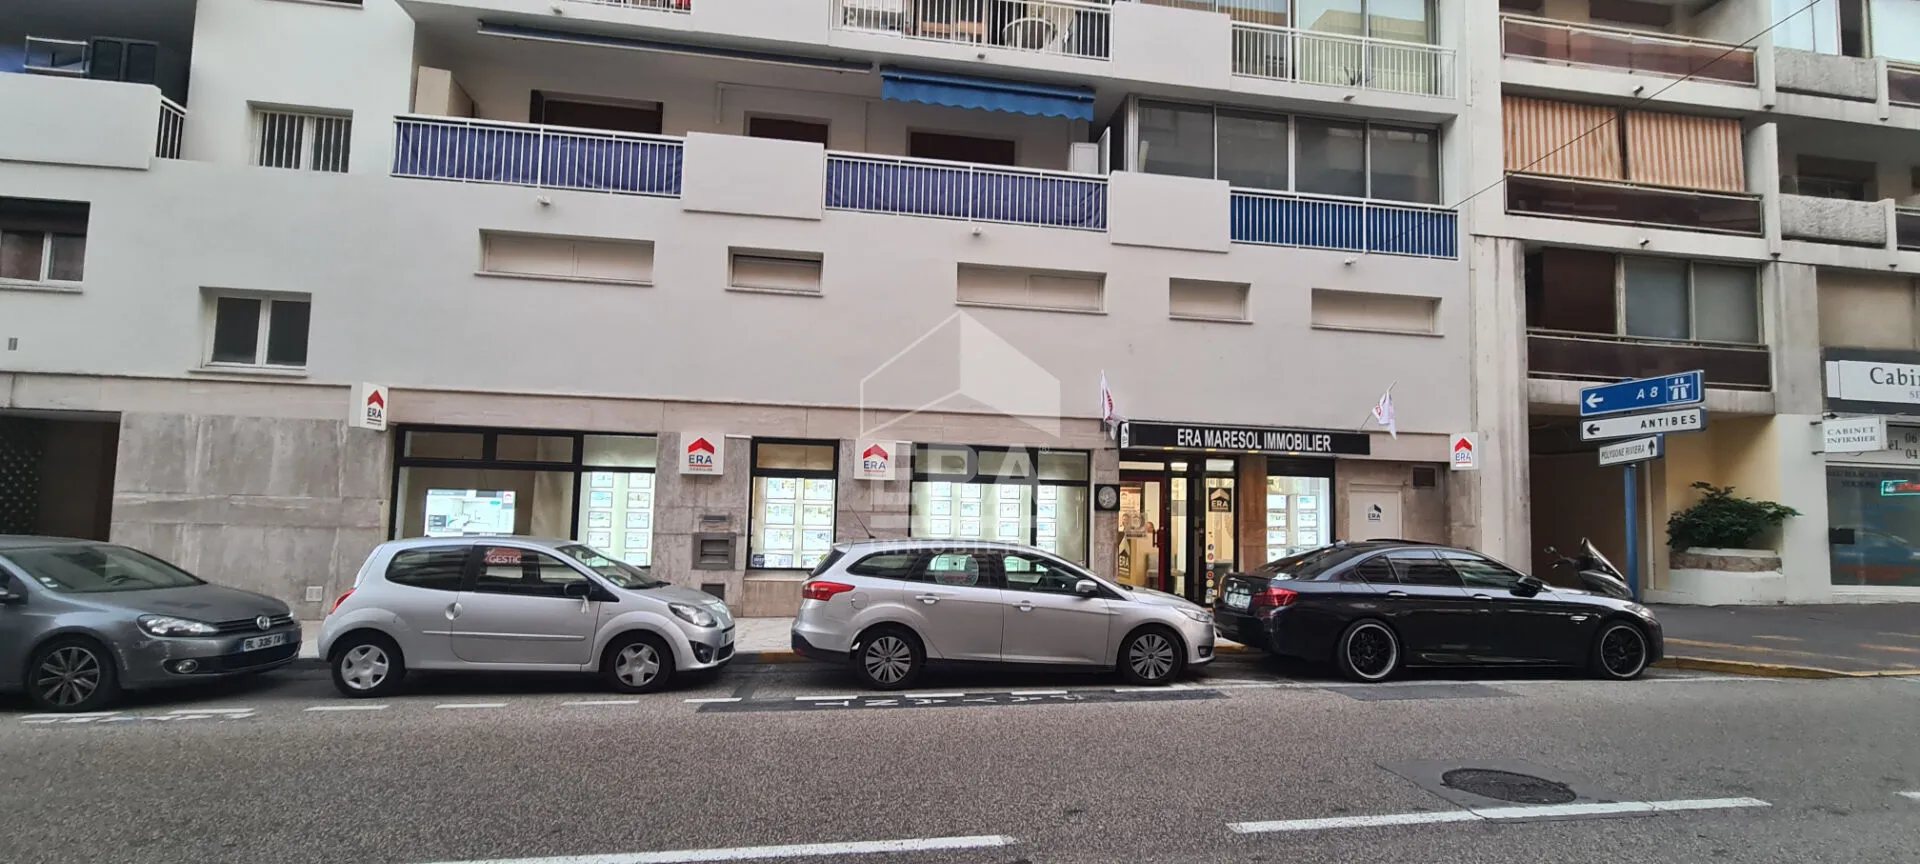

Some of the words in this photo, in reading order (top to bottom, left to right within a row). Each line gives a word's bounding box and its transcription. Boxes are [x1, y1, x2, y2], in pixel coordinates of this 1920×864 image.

[1869, 366, 1920, 386] Cabi
[1636, 388, 1645, 400] A
[1649, 386, 1659, 398] 8
[367, 407, 382, 419] ERA
[1640, 414, 1697, 430] ANTIBES
[1827, 426, 1875, 436] CABINET
[1177, 427, 1201, 447] ERA
[1204, 429, 1262, 449] MARESOL
[1263, 432, 1332, 452] IMMOBILIER
[1827, 435, 1876, 444] INFIRMIER
[1888, 439, 1903, 450] él.
[688, 454, 713, 464] ERA
[1455, 452, 1472, 461] ERA
[863, 460, 887, 470] ERA
[1210, 500, 1229, 509] ERA
